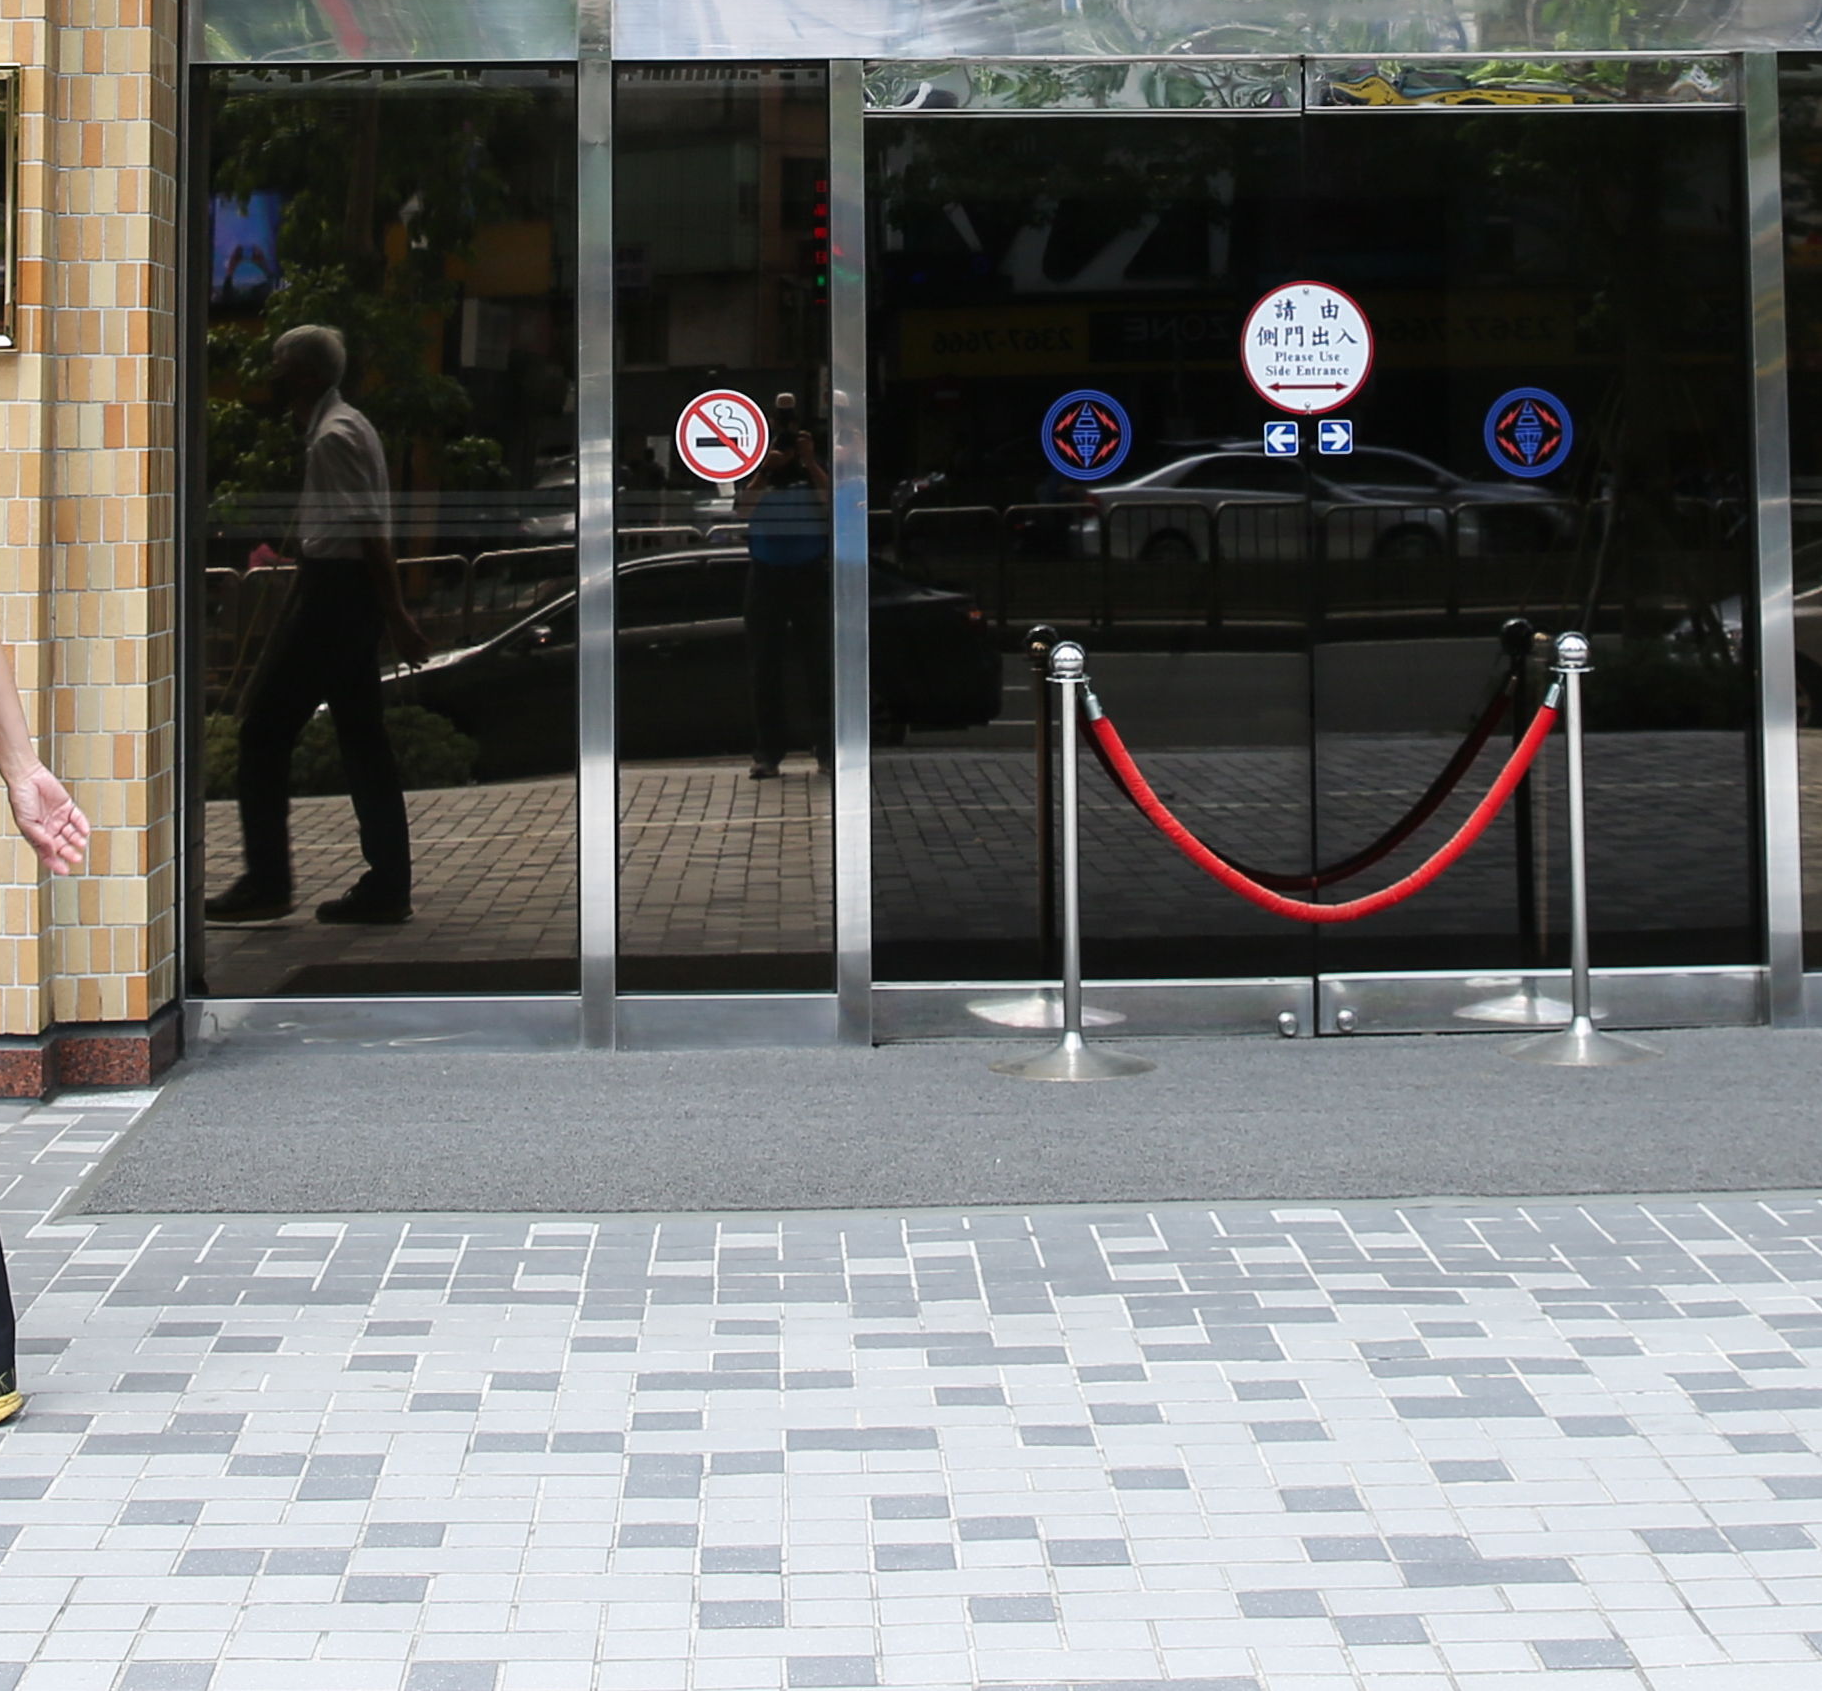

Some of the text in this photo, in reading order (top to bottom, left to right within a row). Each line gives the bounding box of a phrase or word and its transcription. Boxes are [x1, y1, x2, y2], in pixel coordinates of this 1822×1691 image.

[1256, 325, 1359, 348] 側門出入
[1274, 351, 1341, 362] Please Use
[1265, 365, 1350, 376] Side Entrance
